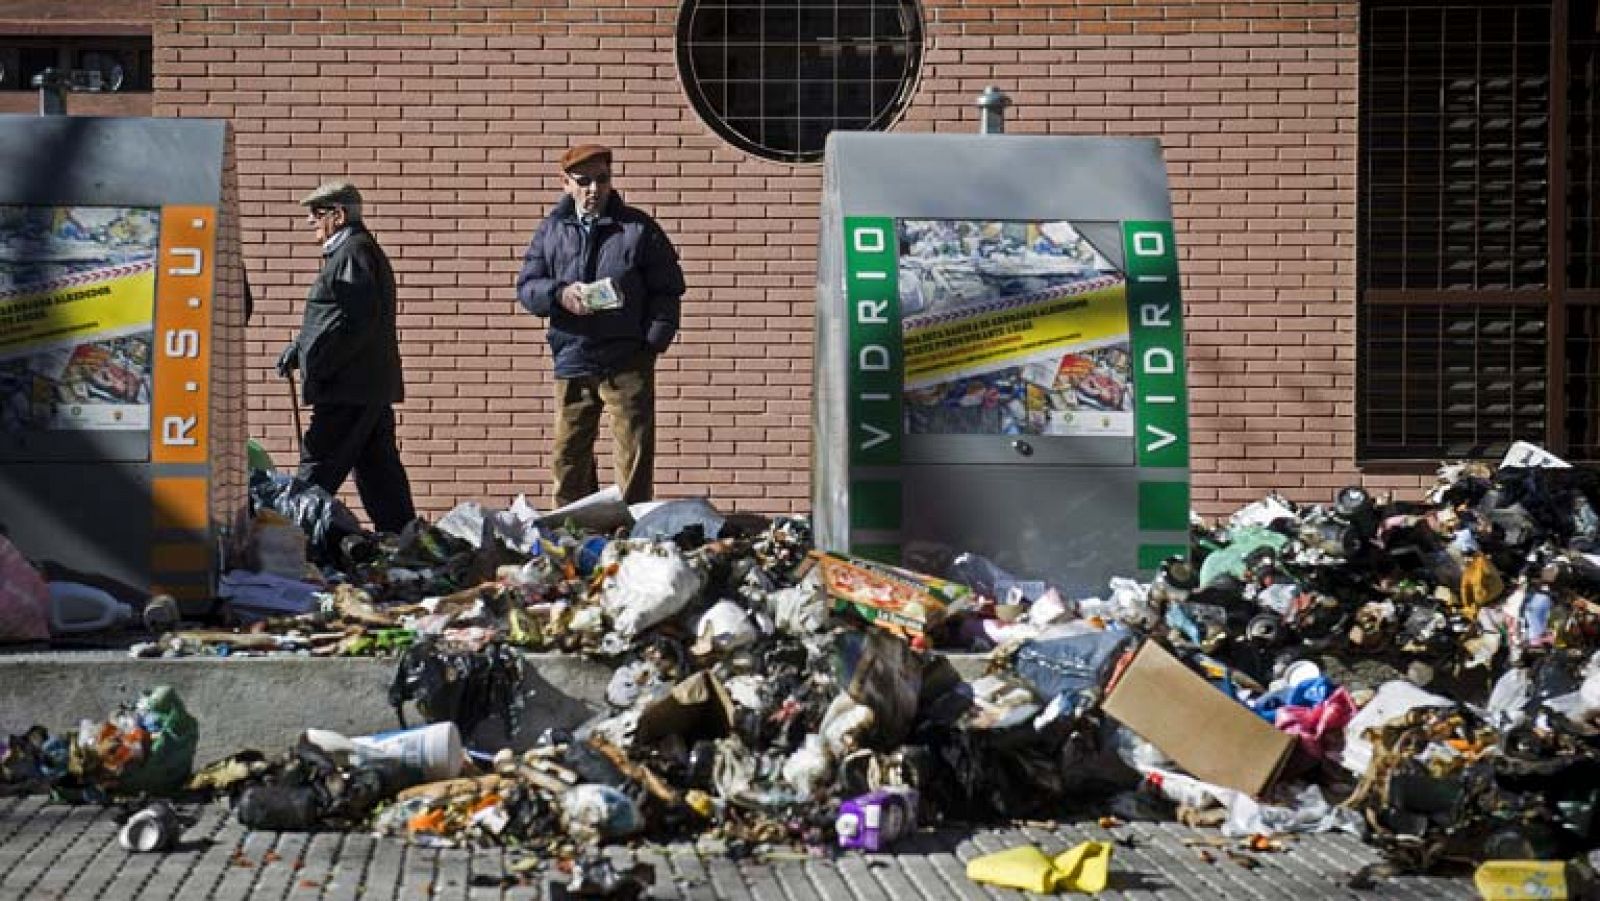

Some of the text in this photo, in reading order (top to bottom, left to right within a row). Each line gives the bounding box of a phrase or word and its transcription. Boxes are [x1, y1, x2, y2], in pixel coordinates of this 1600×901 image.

[162, 218, 204, 446] R.S.U.
[853, 227, 892, 451] VIDRIO
[1133, 231, 1178, 453] VIDRIO
